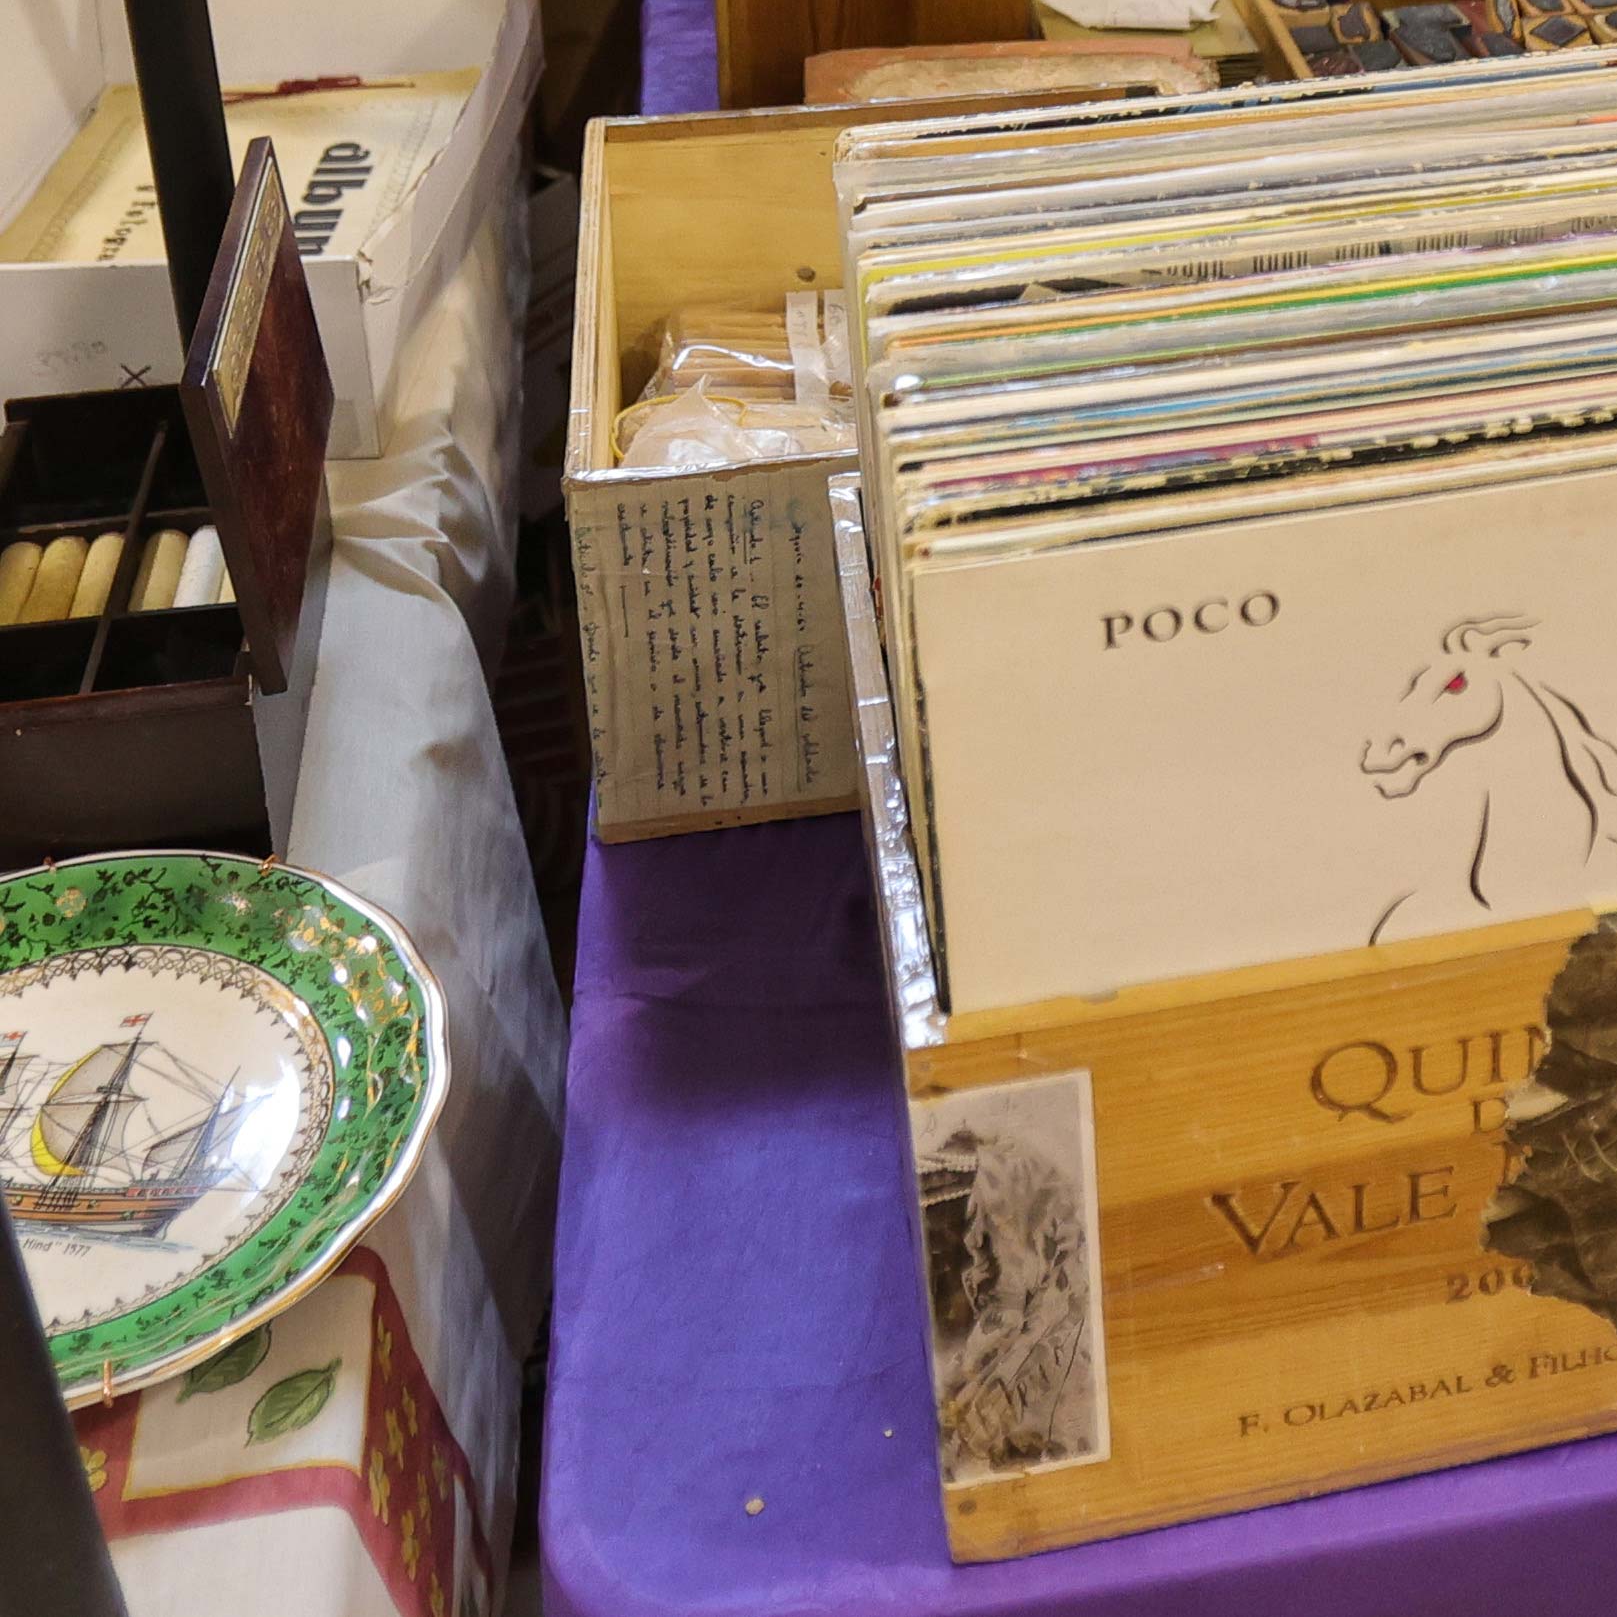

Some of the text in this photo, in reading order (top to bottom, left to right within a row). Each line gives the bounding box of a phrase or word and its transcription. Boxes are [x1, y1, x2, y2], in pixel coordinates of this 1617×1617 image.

[1100, 590, 1281, 651] POCO
[1211, 1165, 1458, 1256] VALE
[1237, 1413, 1270, 1439] F.
[1282, 1374, 1474, 1427] OLAZABAL
[1485, 1363, 1517, 1388] &
